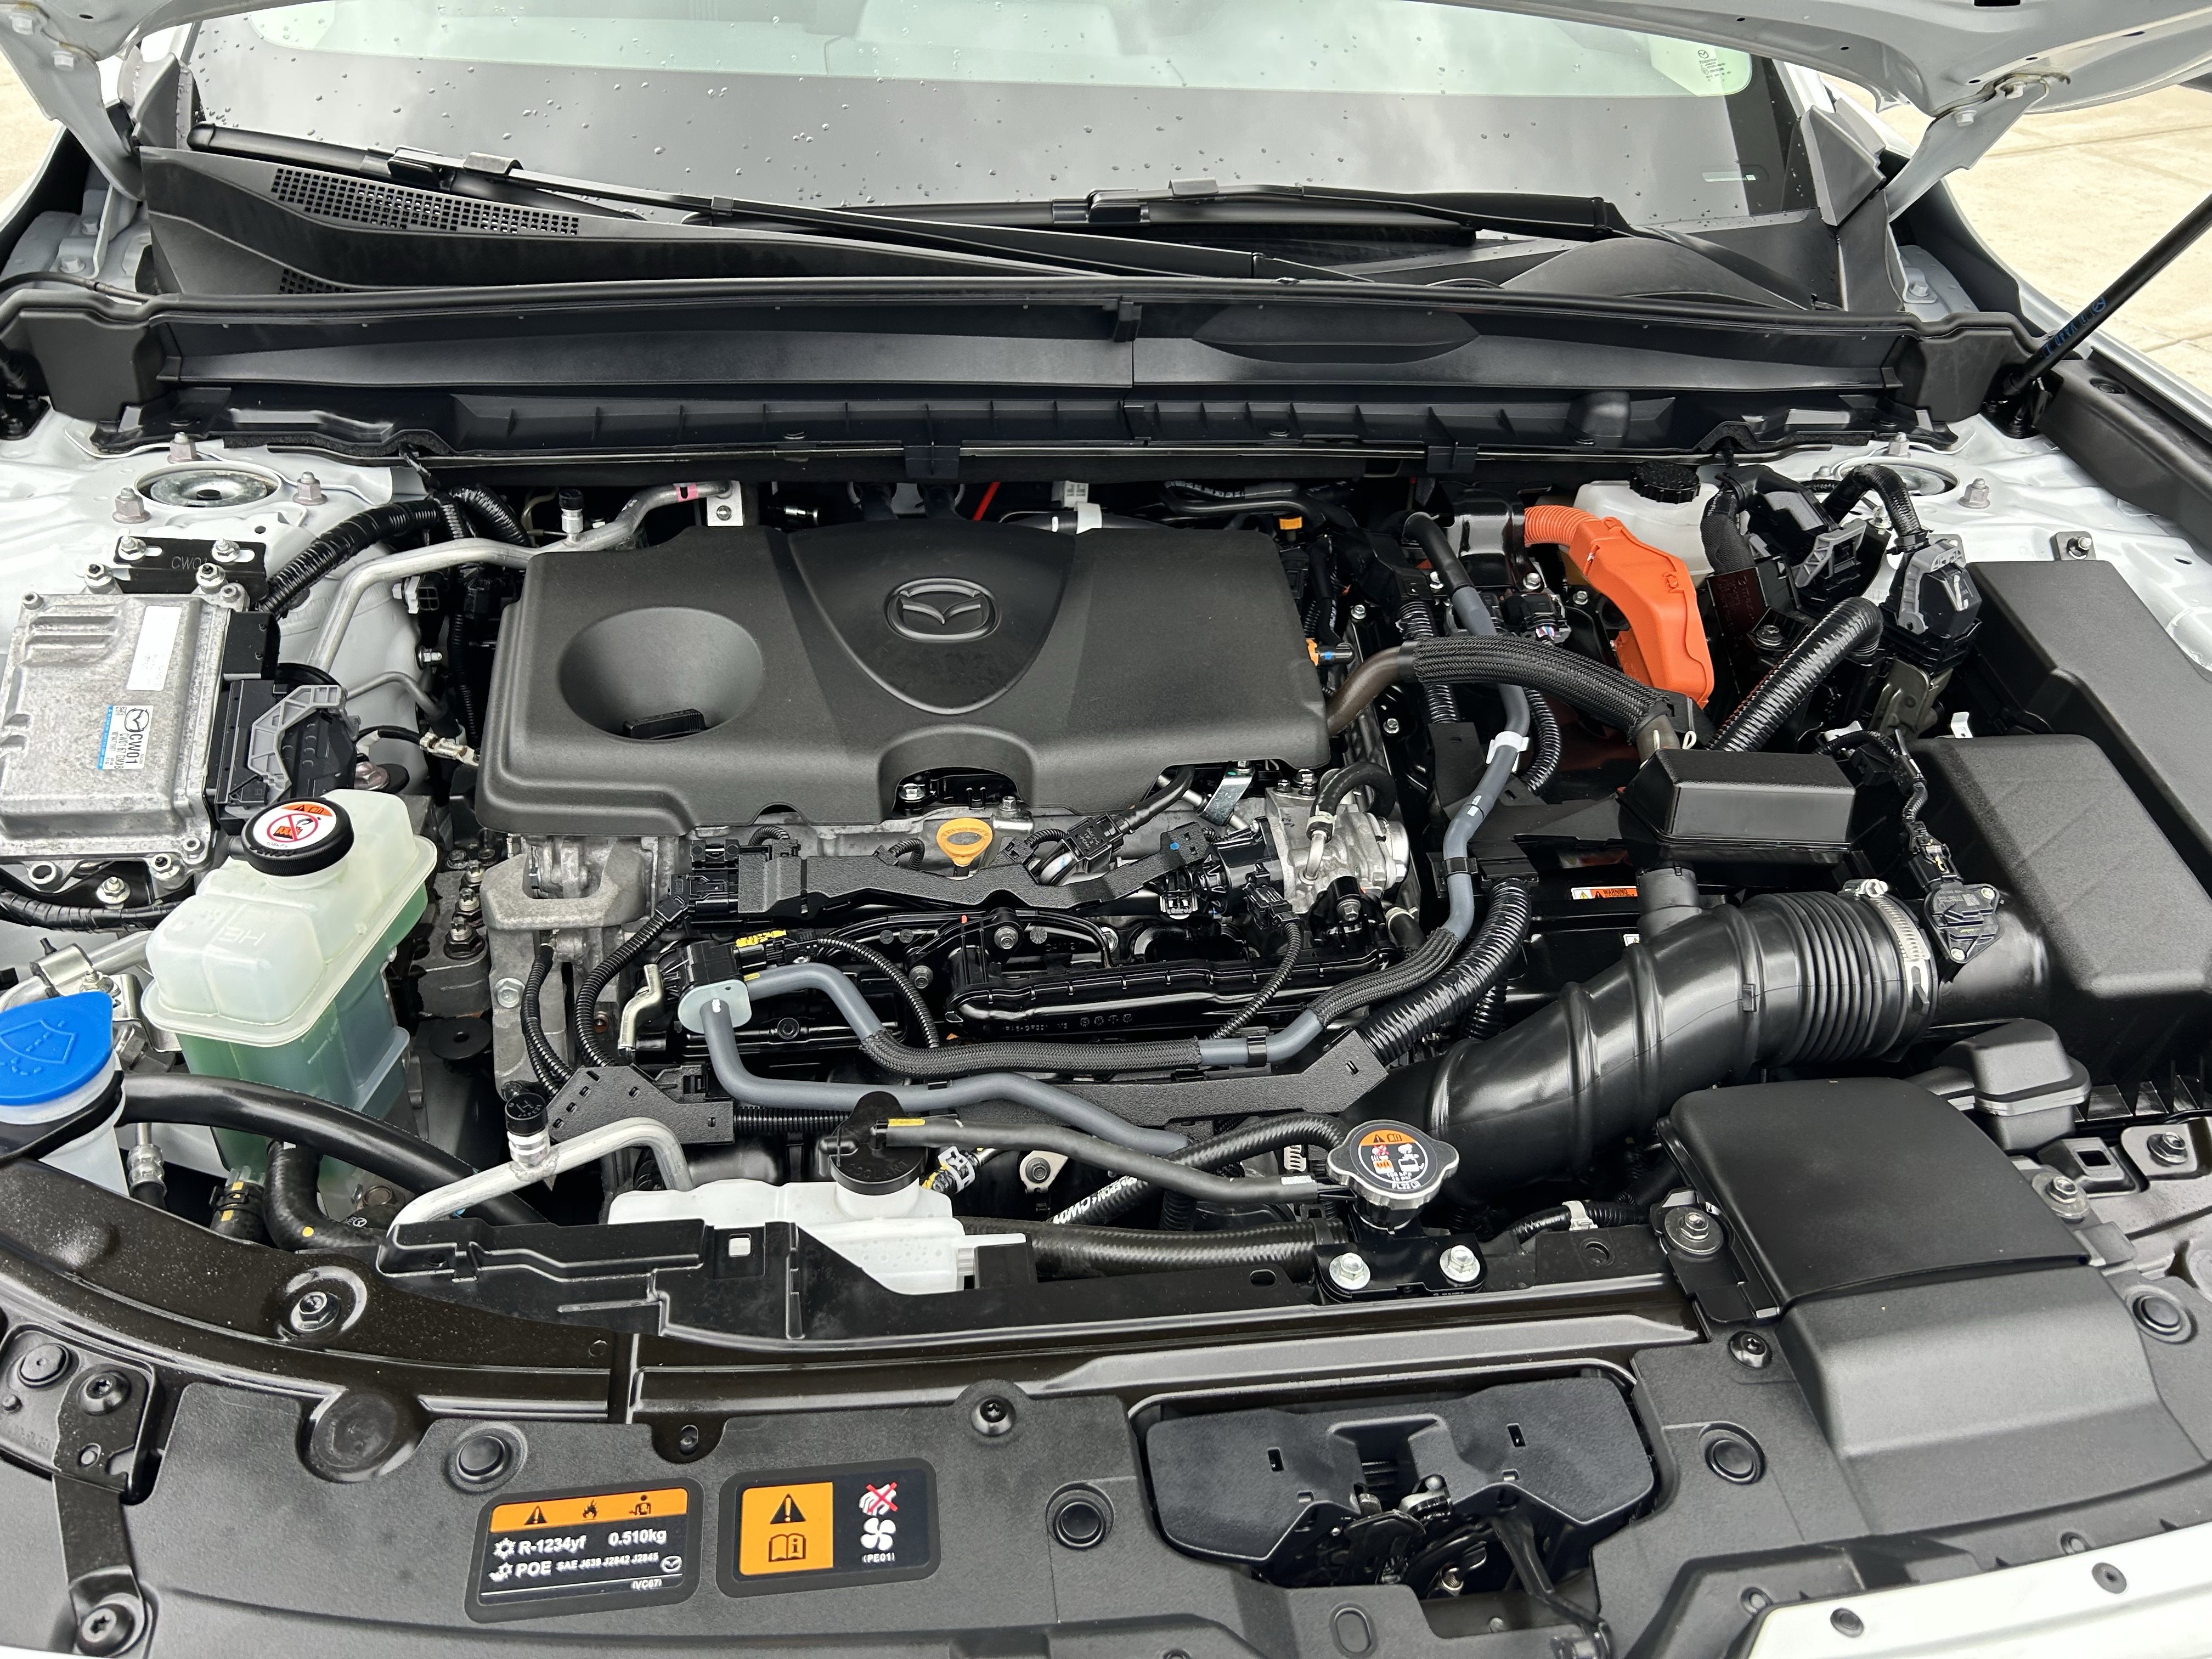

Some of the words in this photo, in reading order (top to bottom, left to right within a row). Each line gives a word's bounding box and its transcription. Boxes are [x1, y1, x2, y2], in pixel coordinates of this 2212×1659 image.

[117, 733, 129, 746] CW01
[125, 733, 143, 763] CW01
[845, 1161, 909, 1179] COOLANT
[517, 1534, 587, 1555] R-1234yf
[607, 1529, 667, 1547] 0.510kg
[515, 1560, 552, 1579] POE
[556, 1560, 578, 1571] SAE
[579, 1559, 601, 1570] J639
[602, 1555, 630, 1567] J2842
[631, 1552, 659, 1565] J2845
[861, 1552, 895, 1563] (PE01)
[630, 1578, 663, 1590] (VC67)
